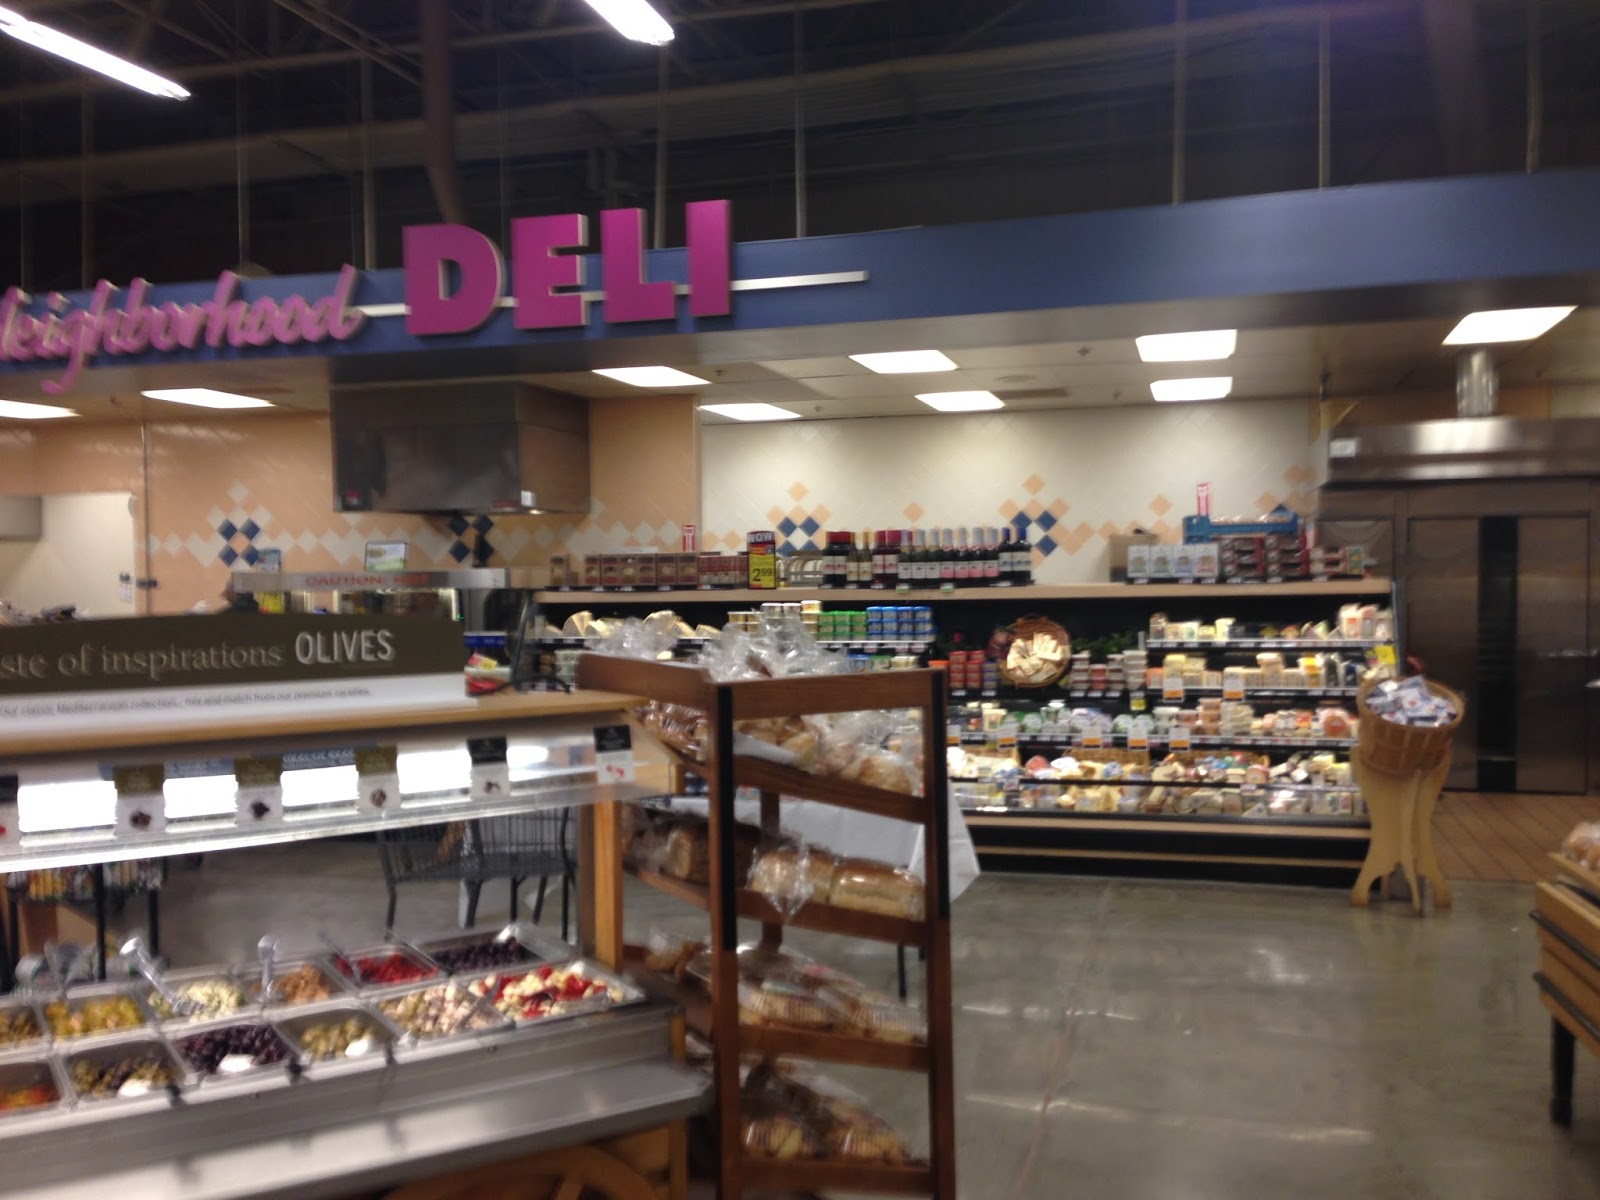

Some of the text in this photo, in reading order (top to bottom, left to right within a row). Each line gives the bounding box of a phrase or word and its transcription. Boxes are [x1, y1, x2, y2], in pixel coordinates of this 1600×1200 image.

[402, 199, 731, 335] DELI
[58, 642, 96, 676] of
[102, 640, 285, 682] inspirations
[295, 628, 395, 665] OLIVES
